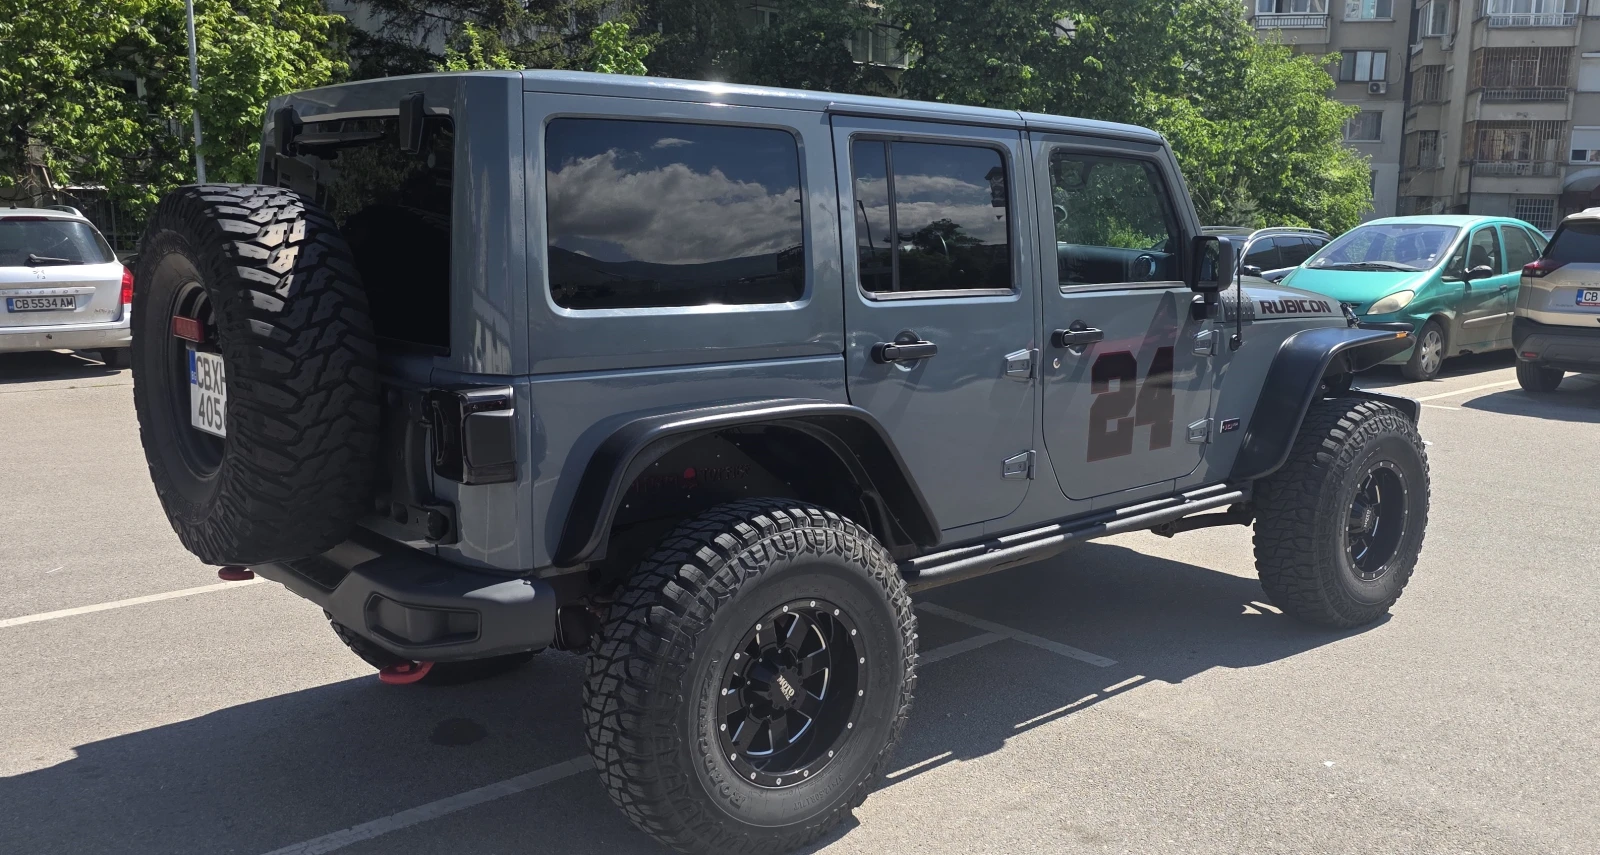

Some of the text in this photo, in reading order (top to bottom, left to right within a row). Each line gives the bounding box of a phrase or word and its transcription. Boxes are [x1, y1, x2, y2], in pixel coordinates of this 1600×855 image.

[31, 298, 58, 309] 5534
[60, 297, 74, 308] AM
[1584, 291, 1598, 302] CB
[1259, 299, 1332, 315] RUBICON
[1086, 345, 1176, 463] 24
[776, 674, 795, 697] MOTO
